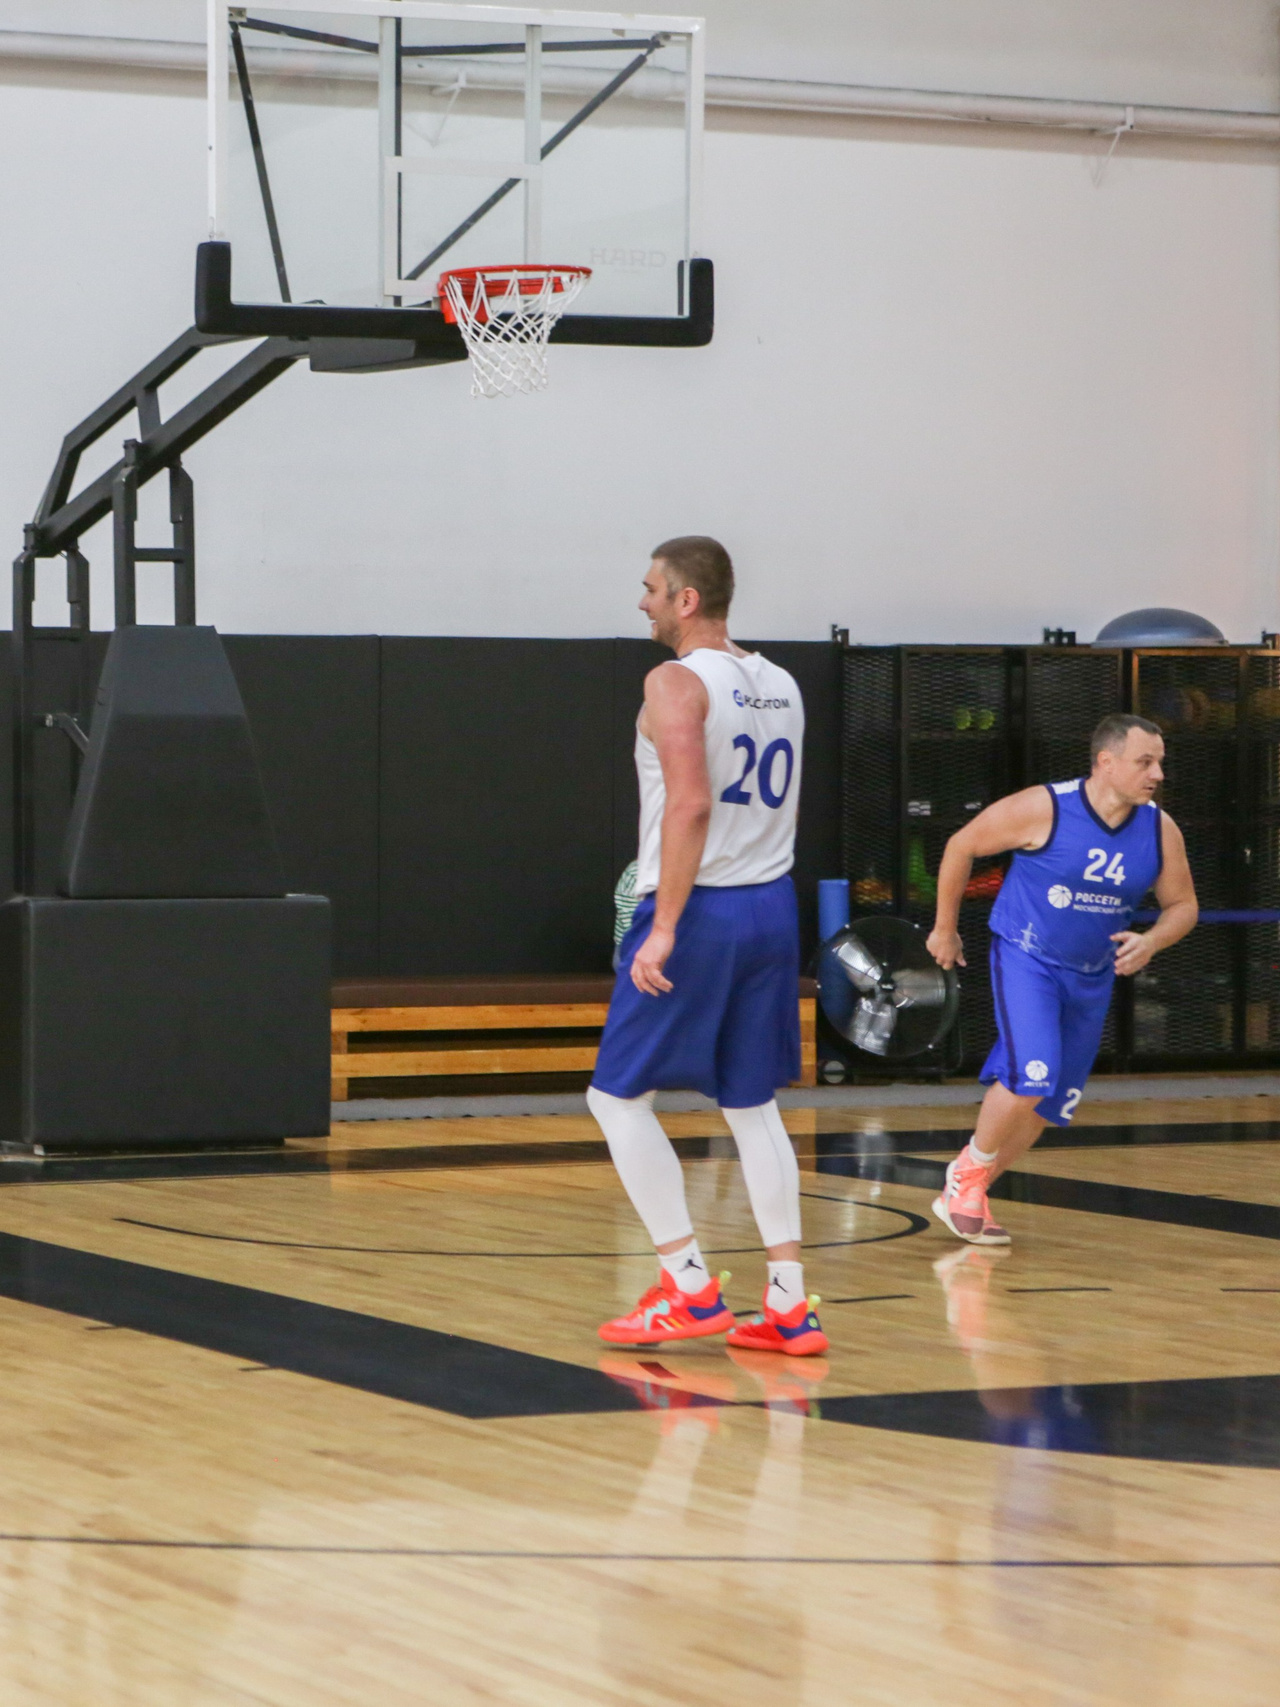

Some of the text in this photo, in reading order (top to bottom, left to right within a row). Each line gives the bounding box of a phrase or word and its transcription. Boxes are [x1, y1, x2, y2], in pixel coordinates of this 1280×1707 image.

[719, 733, 795, 810] 20
[1083, 848, 1127, 886] 24
[1059, 1087, 1083, 1120] 2
